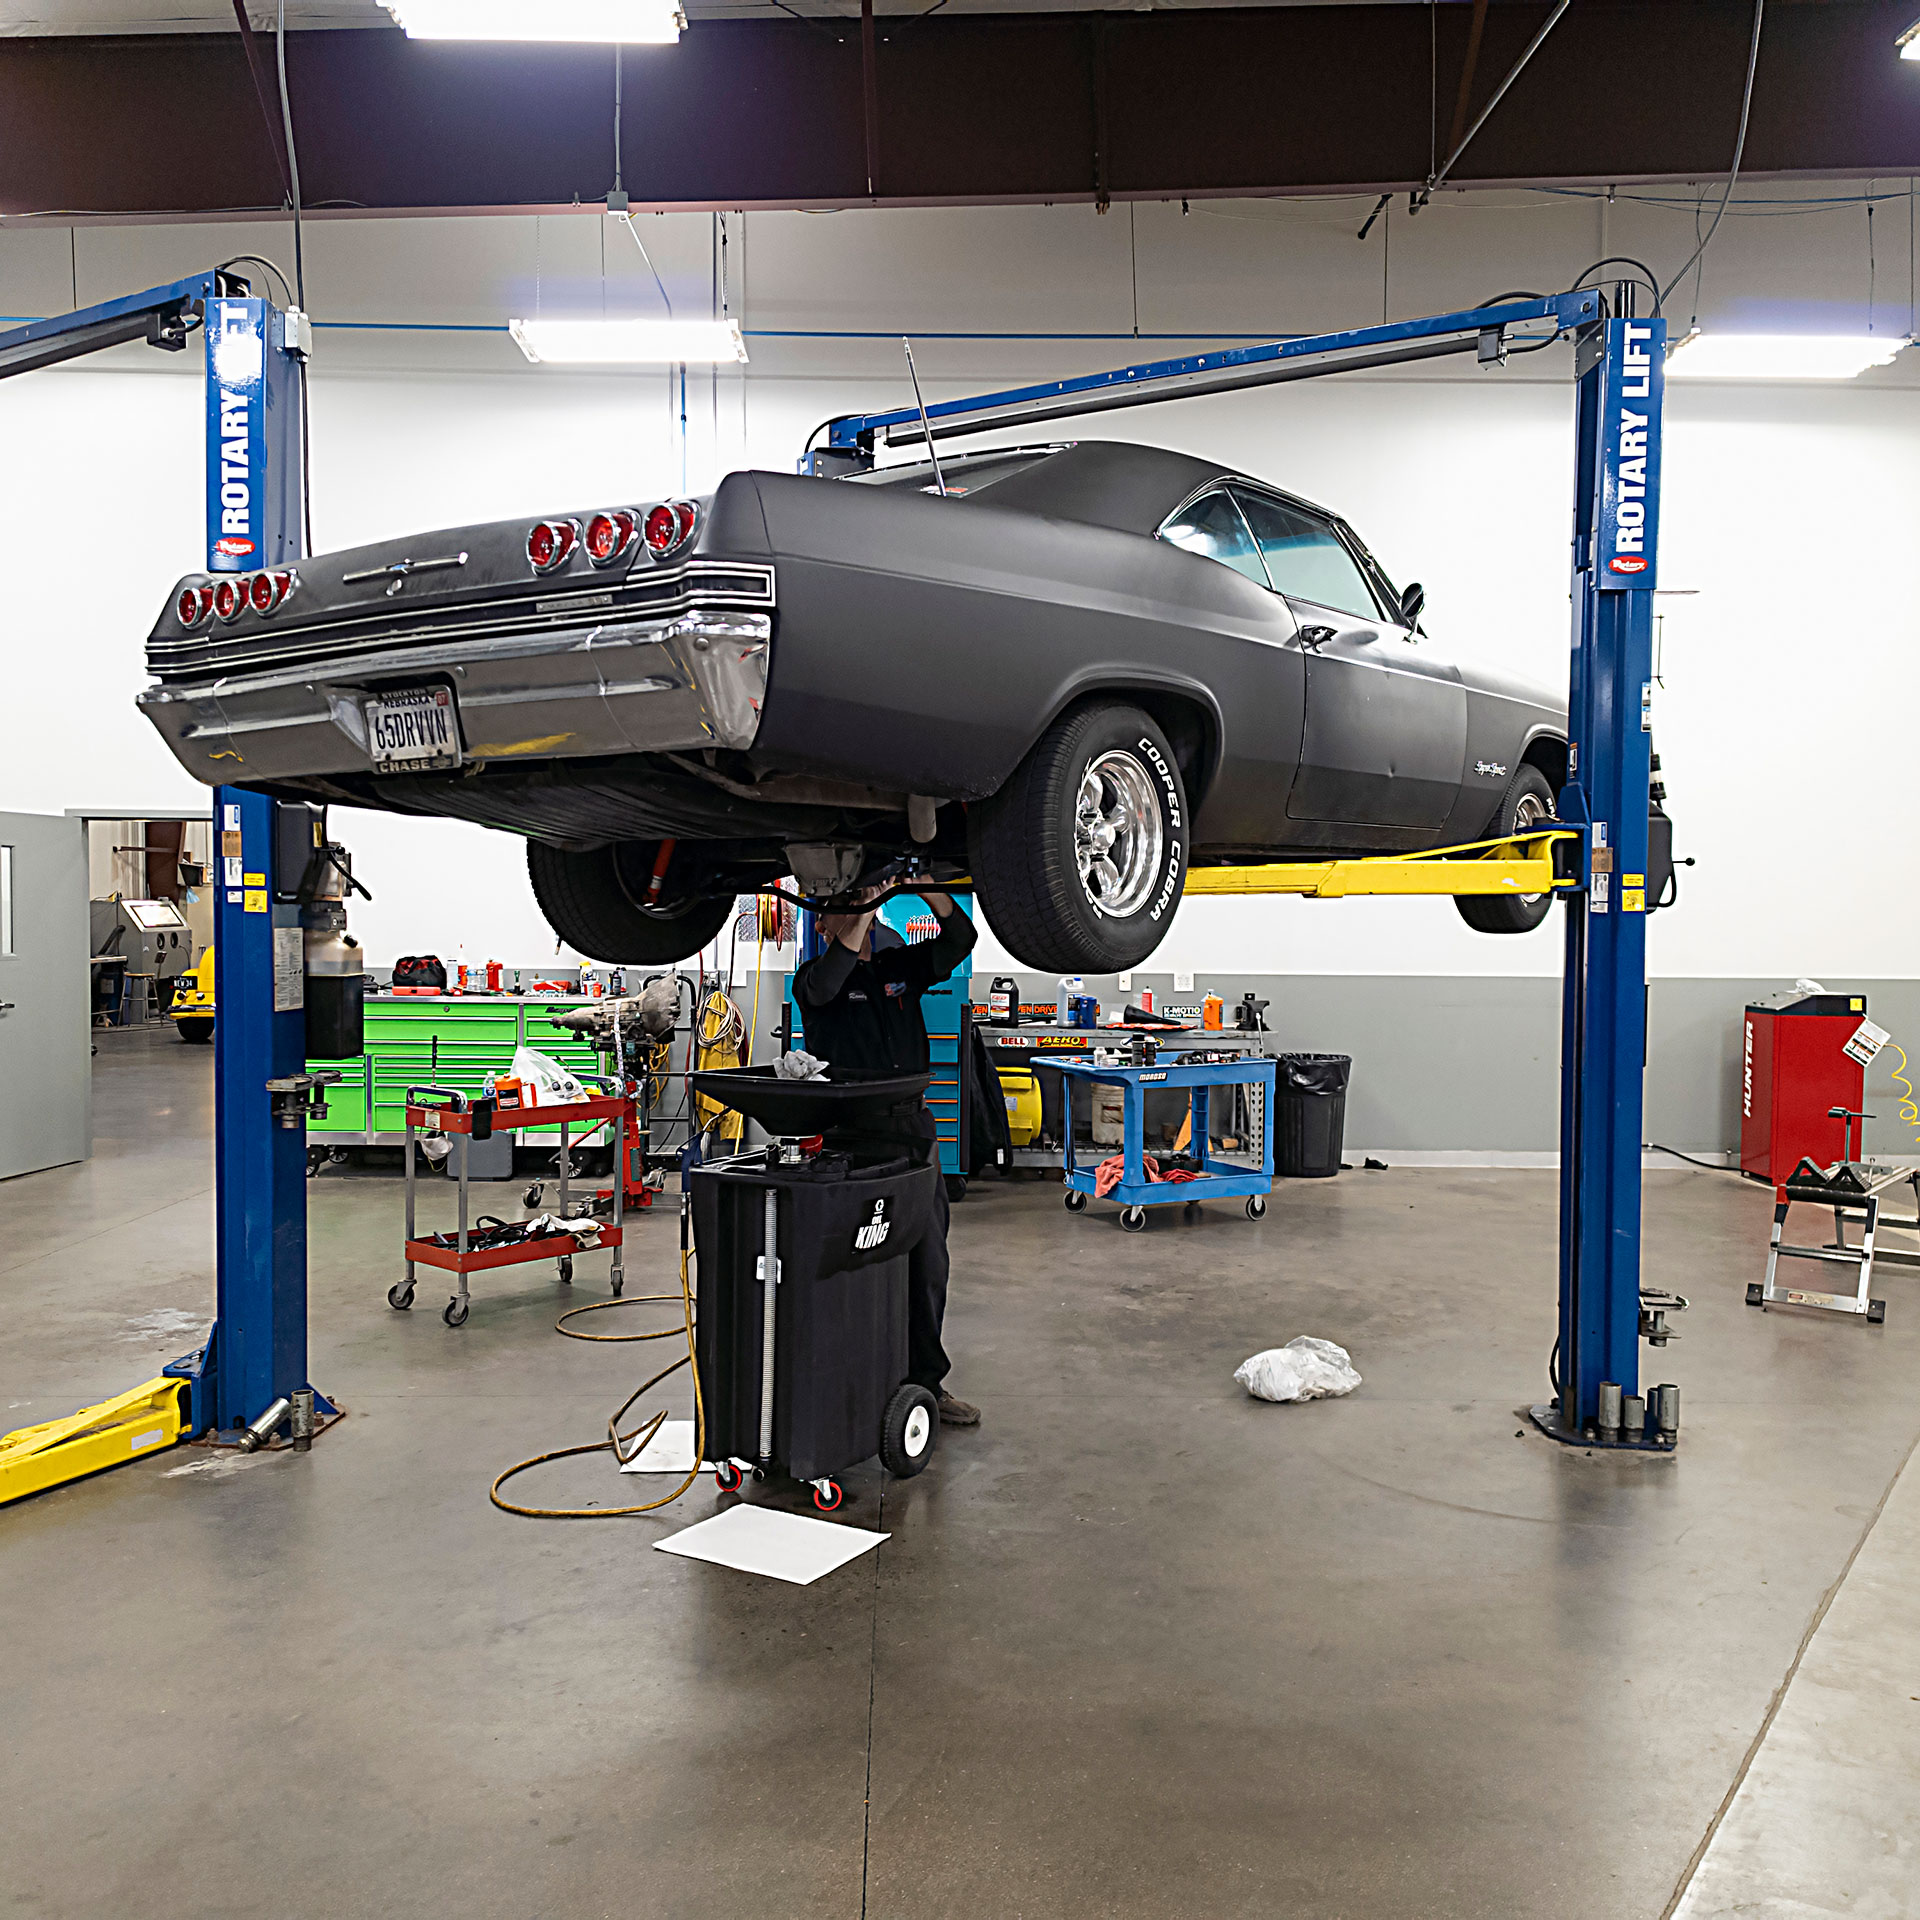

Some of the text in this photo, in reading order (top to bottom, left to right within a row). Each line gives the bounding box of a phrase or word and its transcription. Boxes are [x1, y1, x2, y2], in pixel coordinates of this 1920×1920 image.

[1616, 321, 1652, 552] ROTARY LIFT
[221, 388, 249, 534] ROTARY
[384, 695, 431, 709] NEBRASKA
[375, 709, 449, 750] 65DRVVN
[379, 760, 430, 773] CHASE
[1138, 737, 1181, 921] COOPER COBRA
[1163, 1006, 1201, 1014] K-MOTIO
[1001, 1037, 1025, 1045] BELL
[1743, 1020, 1754, 1118] HUNTER
[855, 1221, 890, 1249] KING
